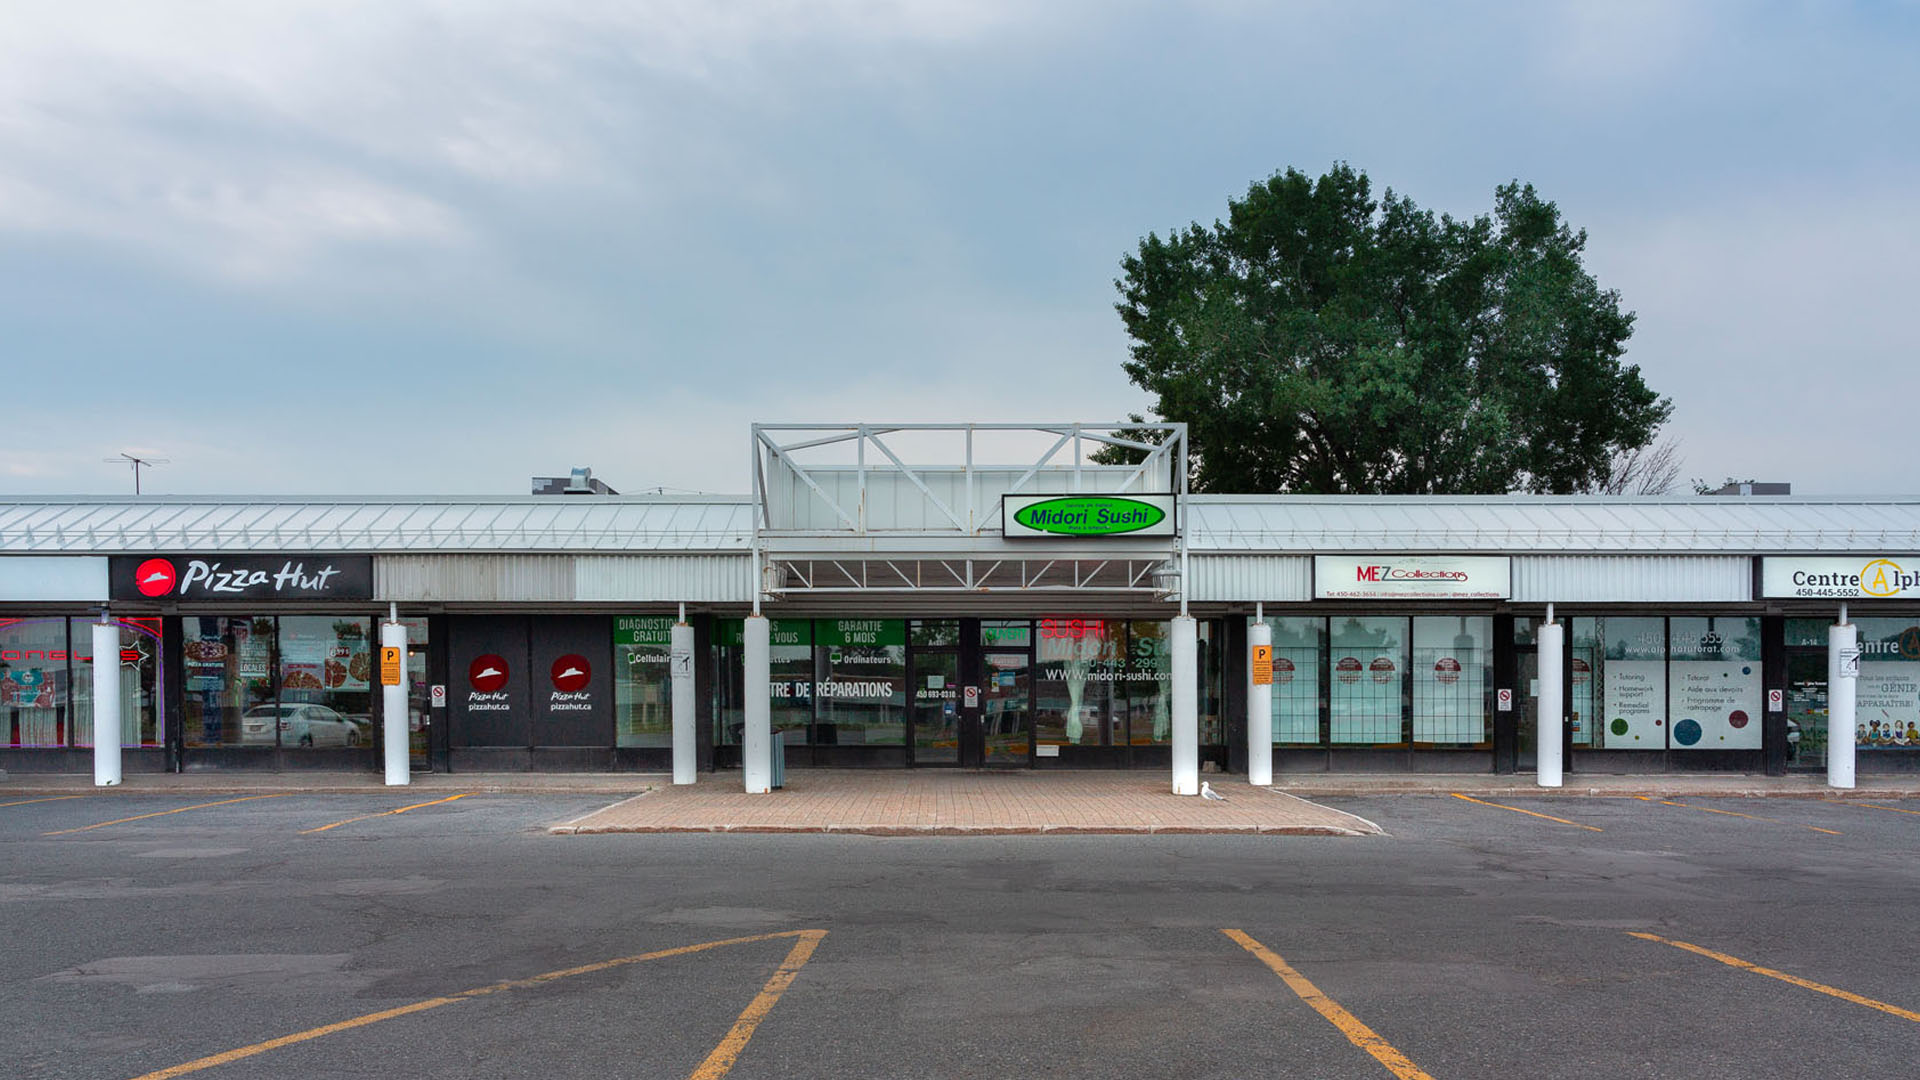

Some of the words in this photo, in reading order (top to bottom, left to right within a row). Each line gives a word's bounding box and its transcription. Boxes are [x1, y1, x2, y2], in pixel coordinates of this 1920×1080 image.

[1030, 509, 1087, 525] Midori
[1096, 508, 1148, 524] Sushi
[180, 560, 269, 595] Pizza
[273, 561, 341, 591] Hut
[1357, 566, 1391, 582] MEZ
[1391, 569, 1468, 582] Collections
[1793, 571, 1860, 587] Centre
[1796, 589, 1859, 597] 450-445-5552
[838, 621, 883, 632] GARANTIE
[1041, 618, 1105, 639] SUSHI
[845, 632, 851, 643] 6
[853, 632, 876, 643] MOIS
[985, 628, 1027, 641] OUVERT
[1046, 637, 1118, 657] Midori
[1856, 639, 1900, 654] entre
[387, 650, 394, 661] P
[635, 654, 671, 663] Cellulair
[843, 655, 892, 664] Ordinateurs
[1258, 648, 1266, 660] P
[1619, 673, 1645, 682] Tutoring
[769, 682, 790, 698] TRE
[796, 682, 810, 698] DE
[816, 677, 893, 698] RÉPARATIONS
[1881, 681, 1917, 693] GÉNIE
[468, 692, 491, 701] Pizza
[492, 692, 509, 701] Hut
[550, 692, 573, 701] Pizza
[574, 692, 591, 701] Hut
[1687, 697, 1725, 705] Programme
[468, 703, 510, 712] pizzahut.ca
[550, 703, 592, 712] pizzahut.ca
[1619, 708, 1650, 716] programs
